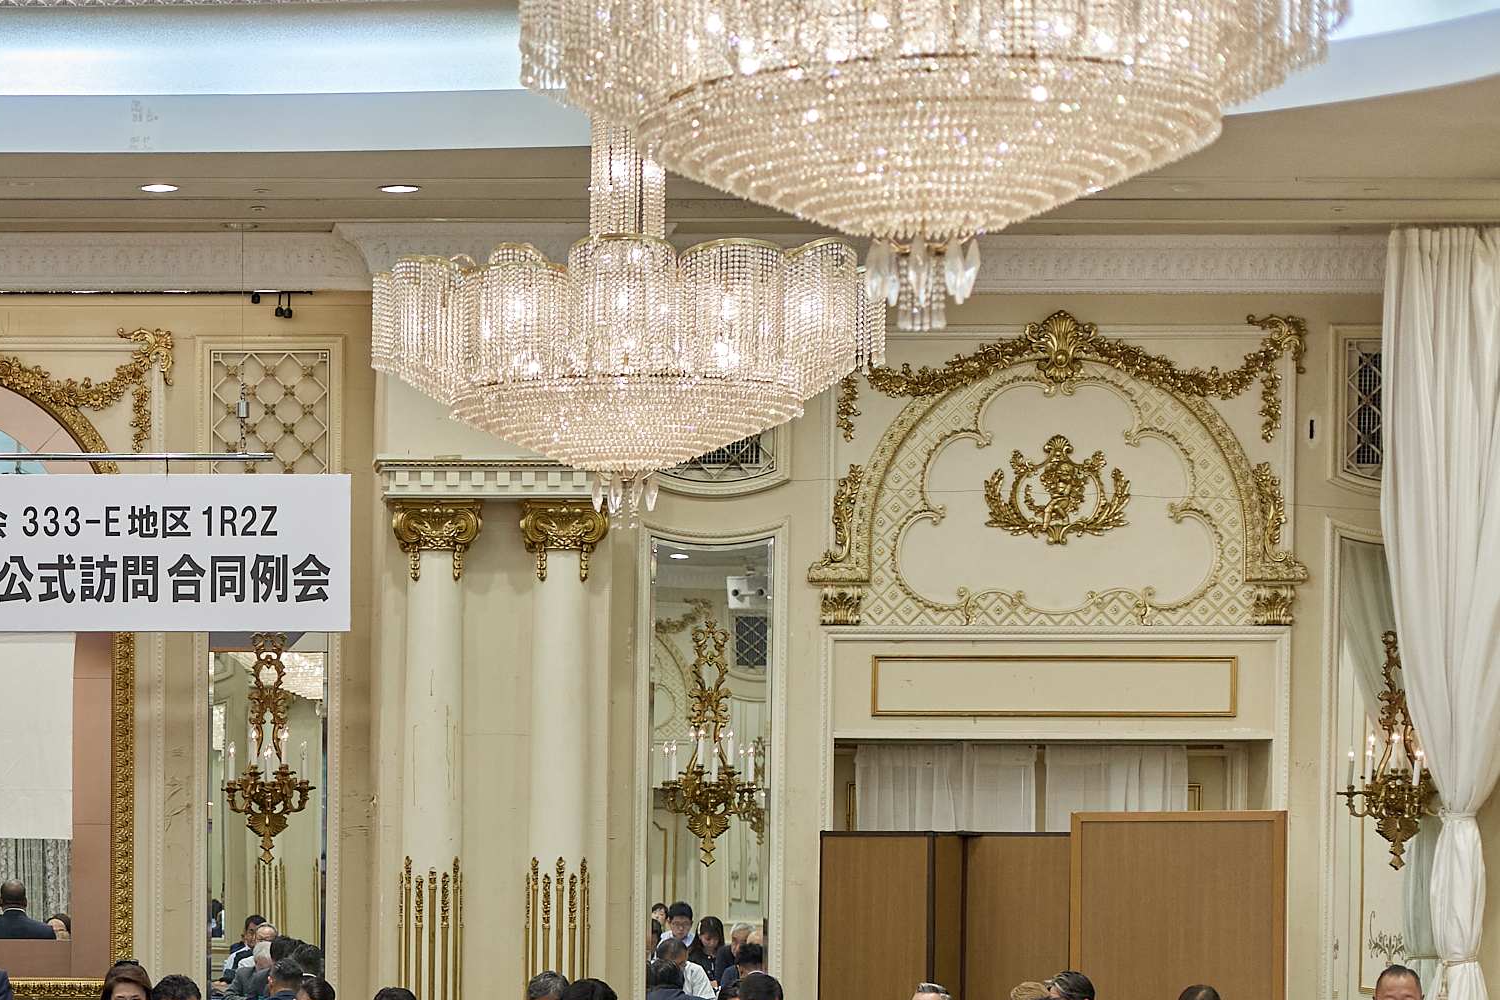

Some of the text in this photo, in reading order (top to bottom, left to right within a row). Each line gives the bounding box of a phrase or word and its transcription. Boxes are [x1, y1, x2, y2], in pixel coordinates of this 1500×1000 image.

[21, 504, 192, 539] 333-E地区
[201, 505, 279, 537] 1R2Z
[167, 554, 331, 603] 合同例会
